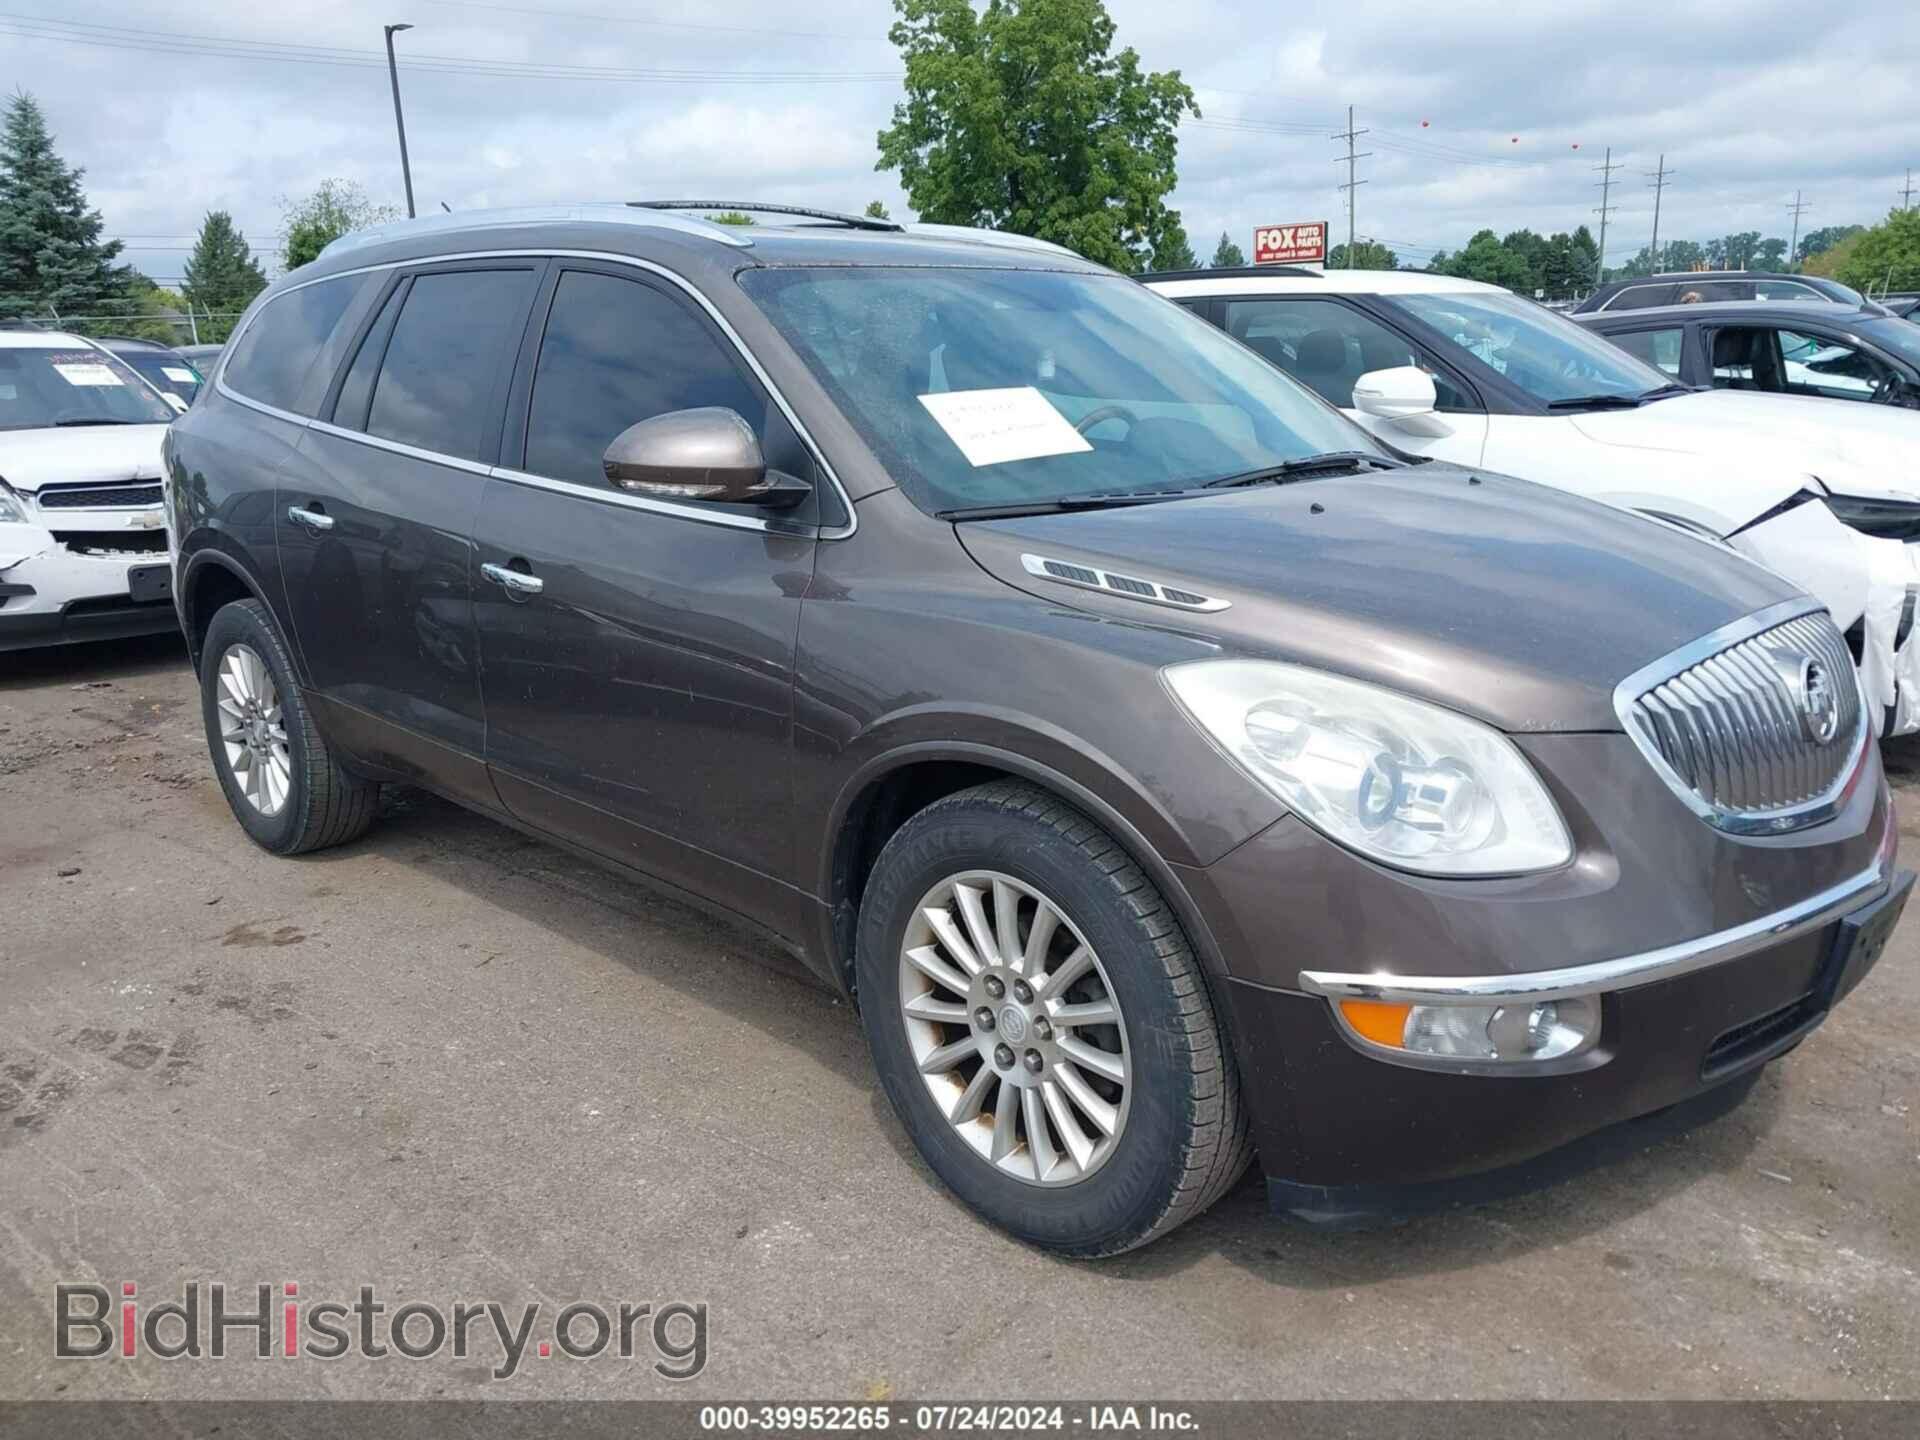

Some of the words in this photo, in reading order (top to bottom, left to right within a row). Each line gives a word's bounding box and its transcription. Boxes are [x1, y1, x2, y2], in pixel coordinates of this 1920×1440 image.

[1296, 226, 1319, 237] AUTO
[1257, 228, 1296, 251] FOX
[1296, 237, 1321, 247] PARTS
